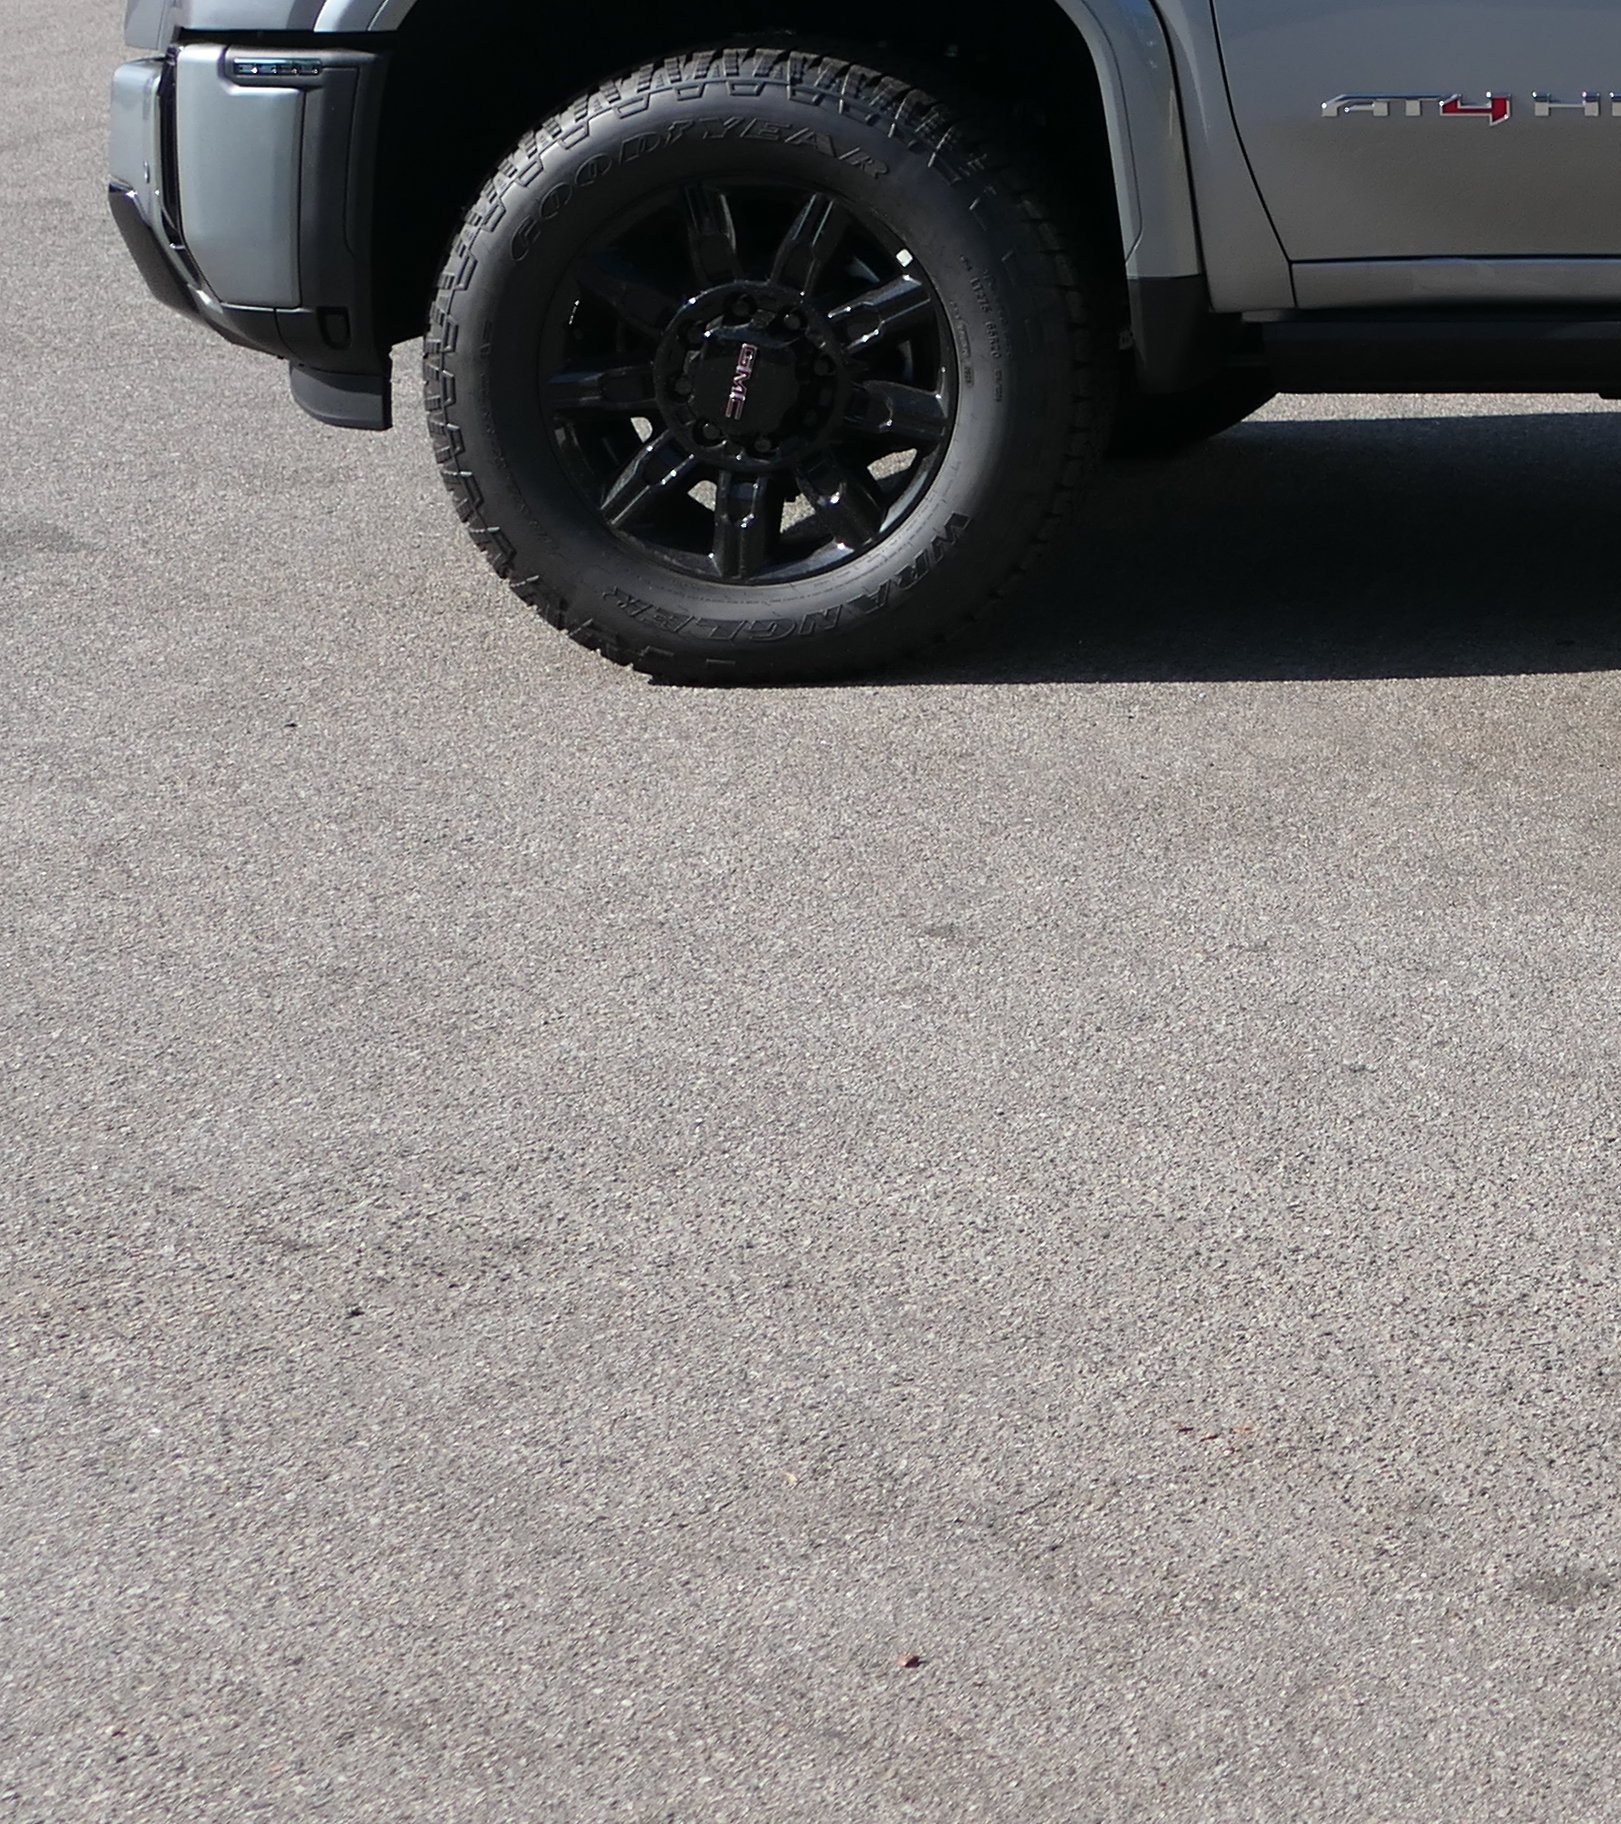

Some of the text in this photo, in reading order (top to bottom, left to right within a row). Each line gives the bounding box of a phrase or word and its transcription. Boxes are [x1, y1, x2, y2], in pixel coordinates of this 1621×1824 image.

[511, 117, 888, 262] GOODYEAR
[725, 343, 757, 420] GMC
[602, 512, 972, 646] WRANGLER
